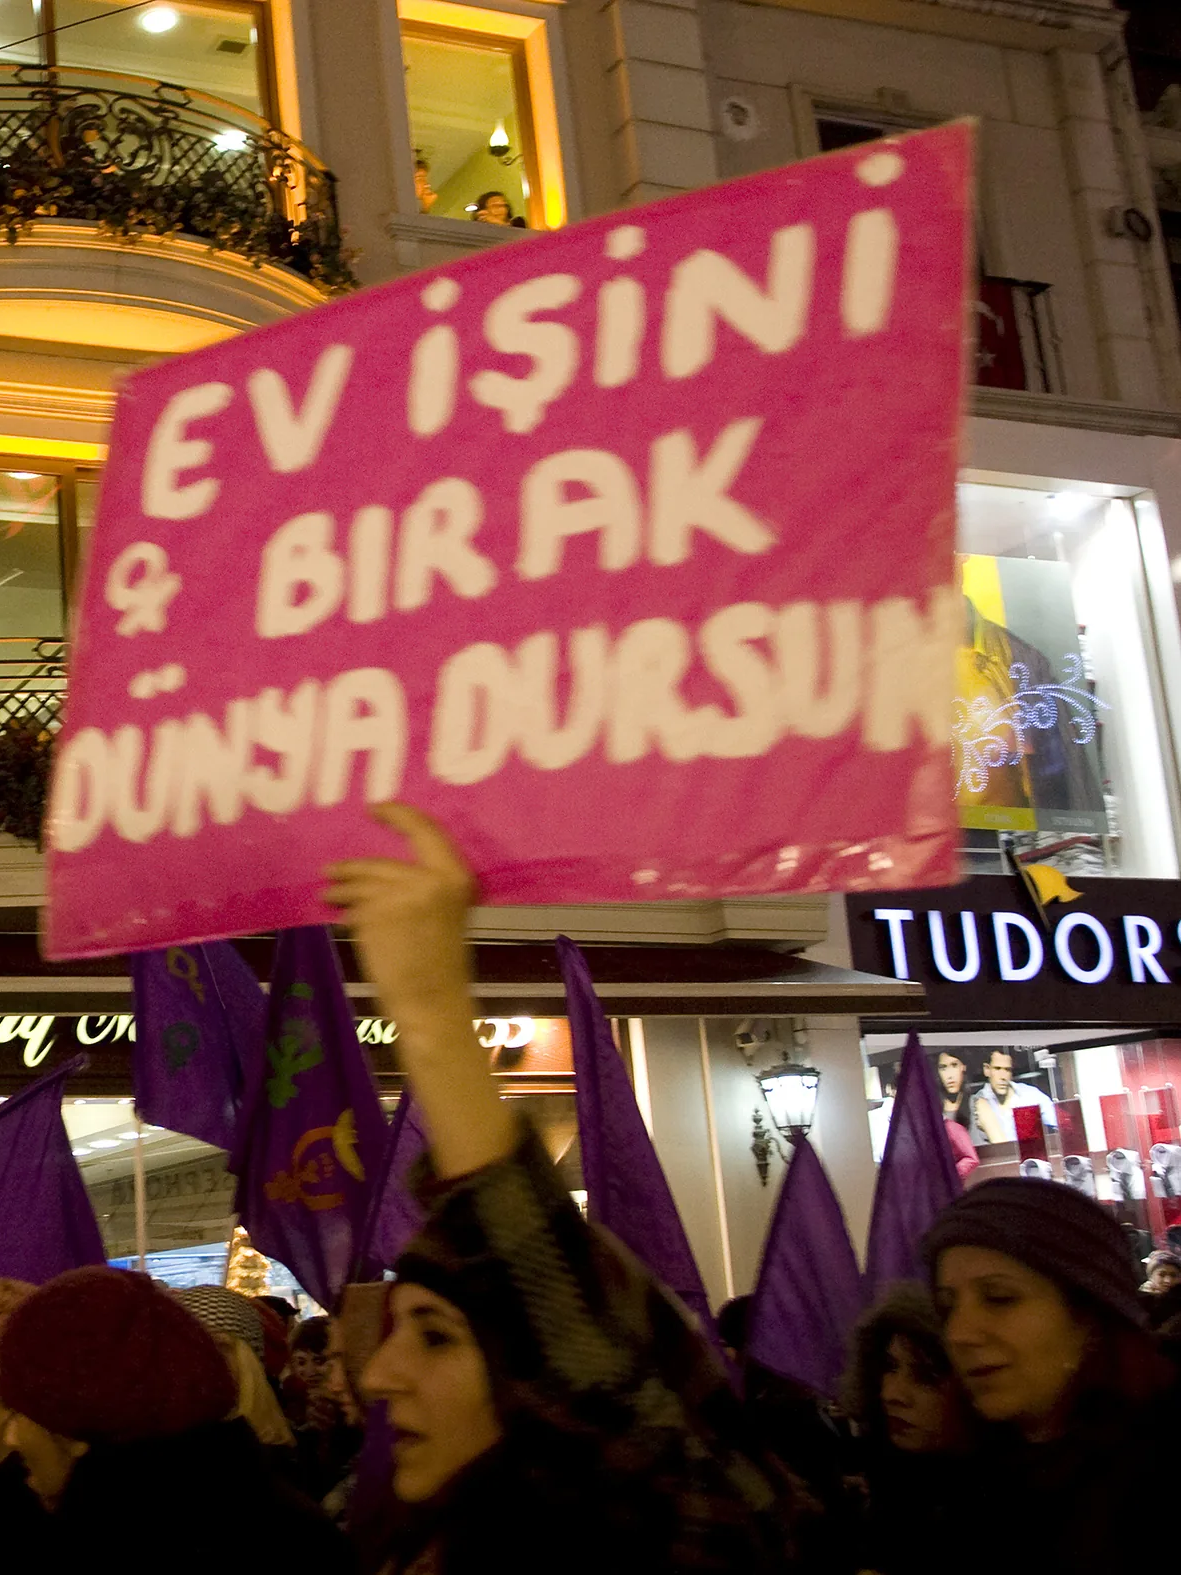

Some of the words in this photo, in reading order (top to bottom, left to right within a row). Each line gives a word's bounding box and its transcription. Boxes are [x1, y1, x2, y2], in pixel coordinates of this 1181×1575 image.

[143, 345, 352, 519] EV
[409, 154, 903, 436] İŞİNİ
[256, 418, 776, 638] BIRAK
[49, 664, 409, 851] DÜNYA
[429, 583, 959, 785] DURSUN
[875, 908, 1181, 984] TUDOR
